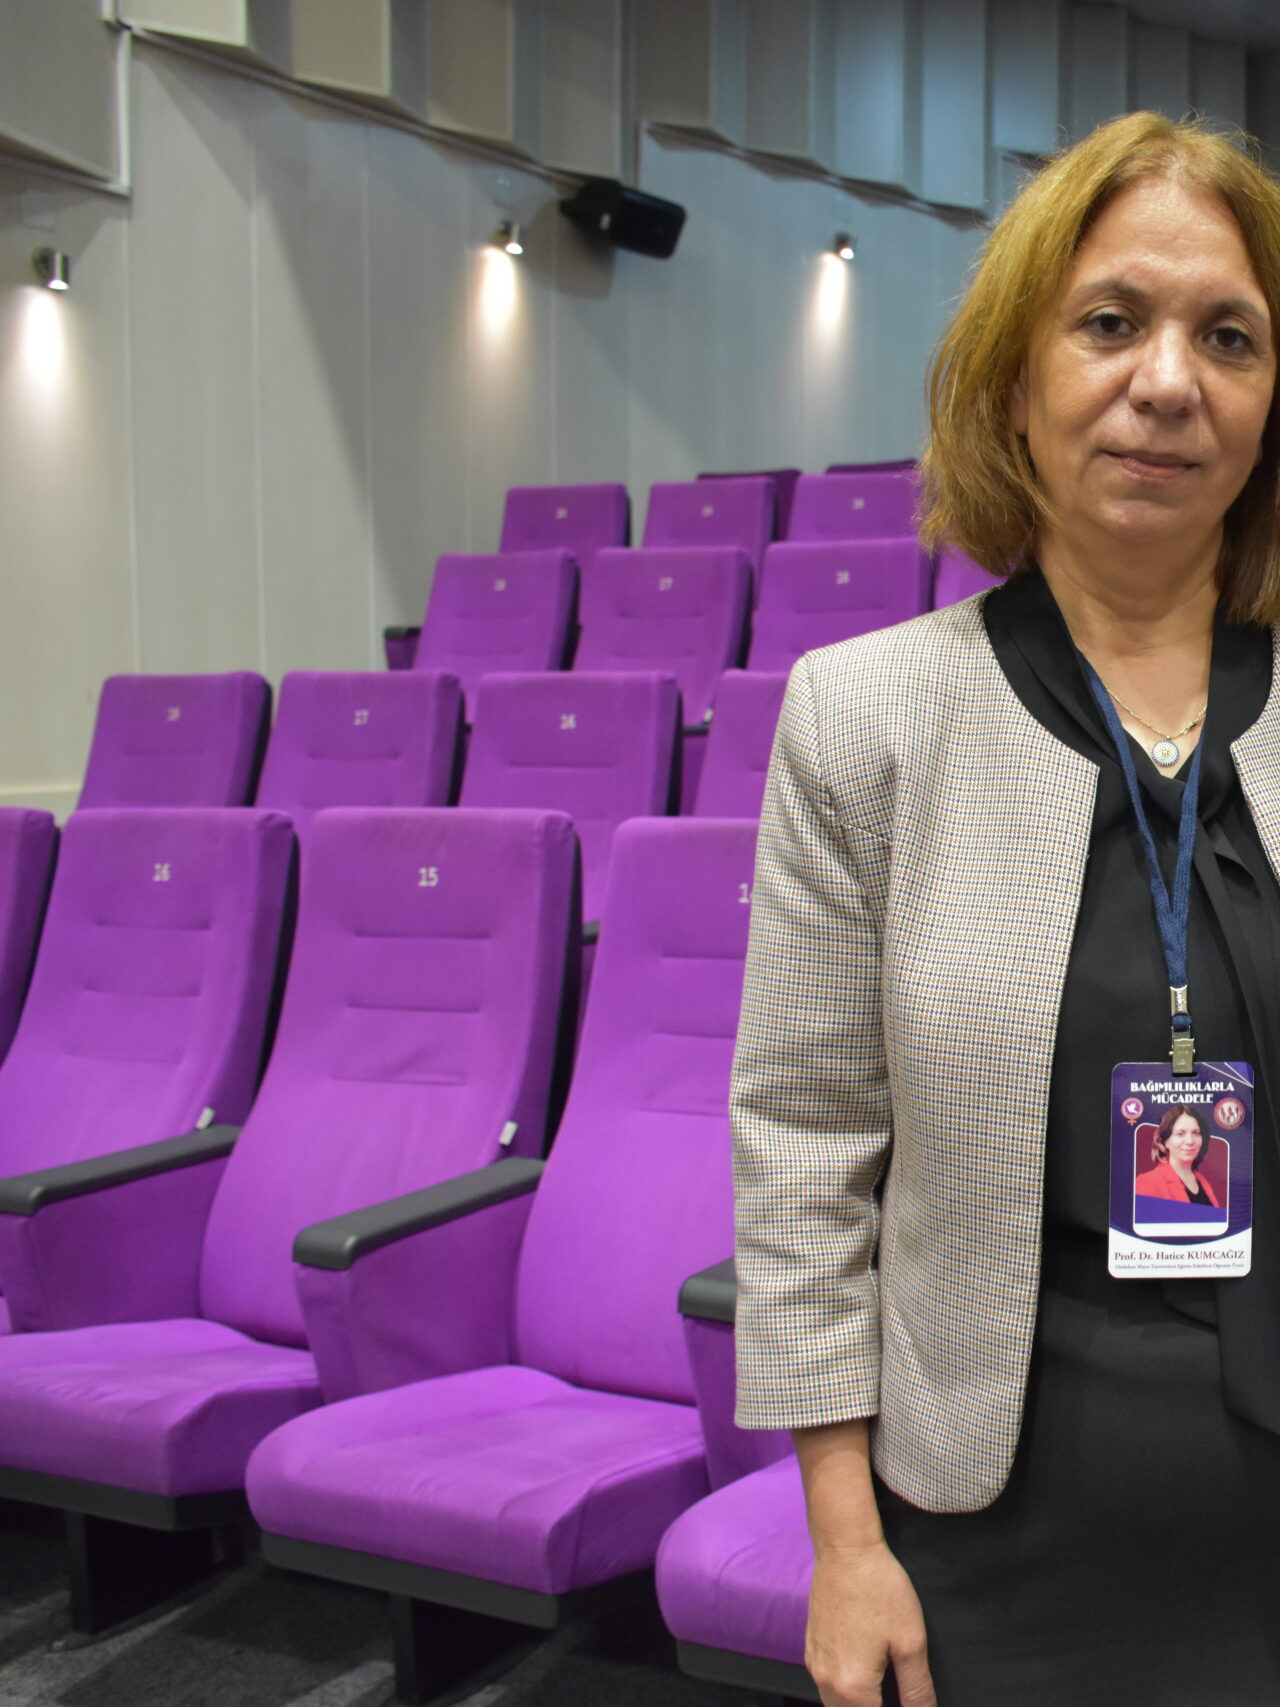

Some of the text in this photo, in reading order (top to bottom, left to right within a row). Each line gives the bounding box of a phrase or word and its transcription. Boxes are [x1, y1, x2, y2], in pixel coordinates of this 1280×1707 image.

[418, 866, 439, 887] 15
[738, 883, 752, 904] 1
[1130, 1080, 1235, 1092] BAĞIMLILIKLARLA
[1151, 1092, 1214, 1104] MÜCADELE
[1114, 1249, 1245, 1261] Prof. Dr. Hatice KUMCAĞIZ
